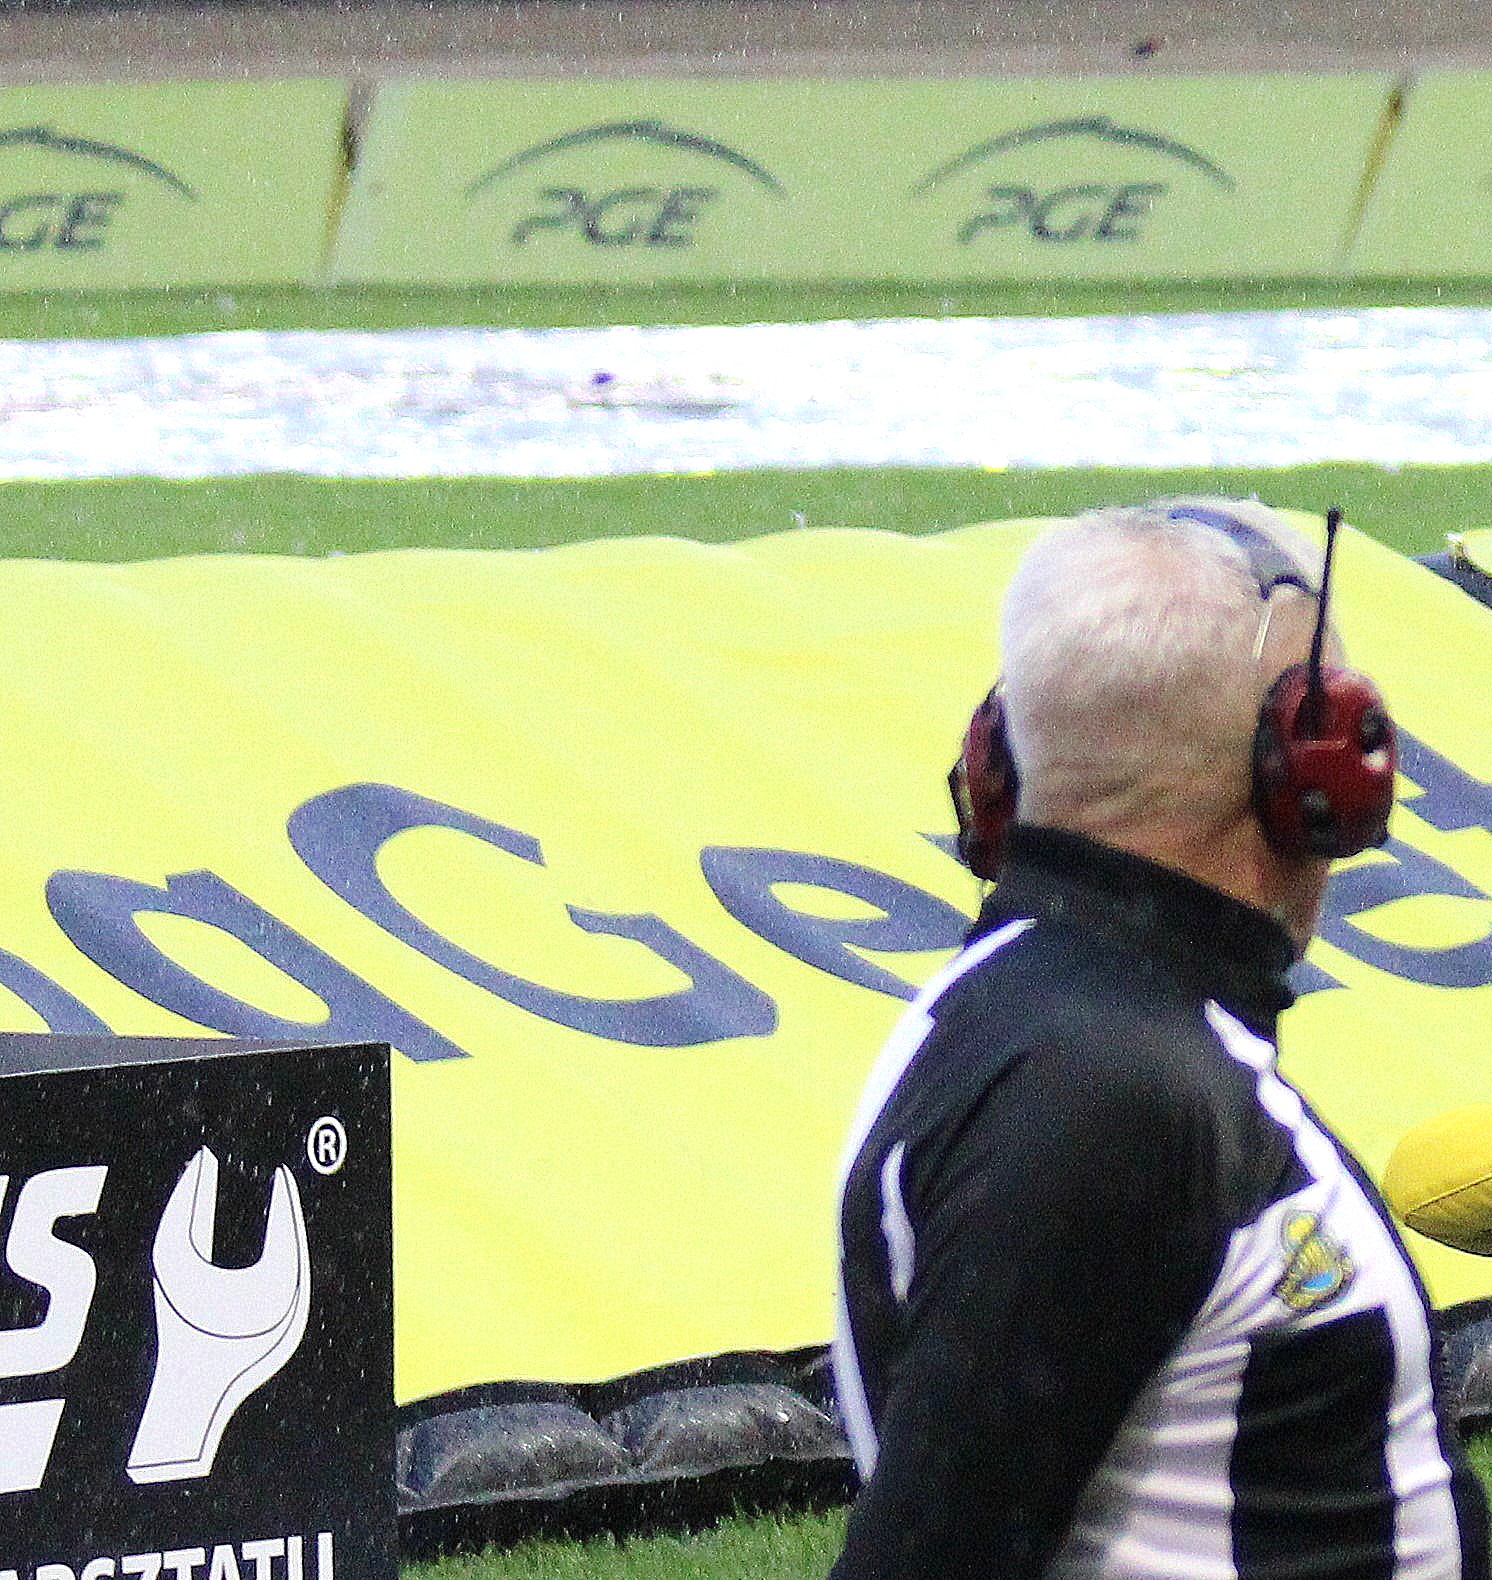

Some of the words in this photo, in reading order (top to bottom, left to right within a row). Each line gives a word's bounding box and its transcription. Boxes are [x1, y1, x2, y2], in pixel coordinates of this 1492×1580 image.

[0, 191, 125, 252] GE
[512, 186, 721, 247] PGE
[957, 181, 1169, 246] PGE
